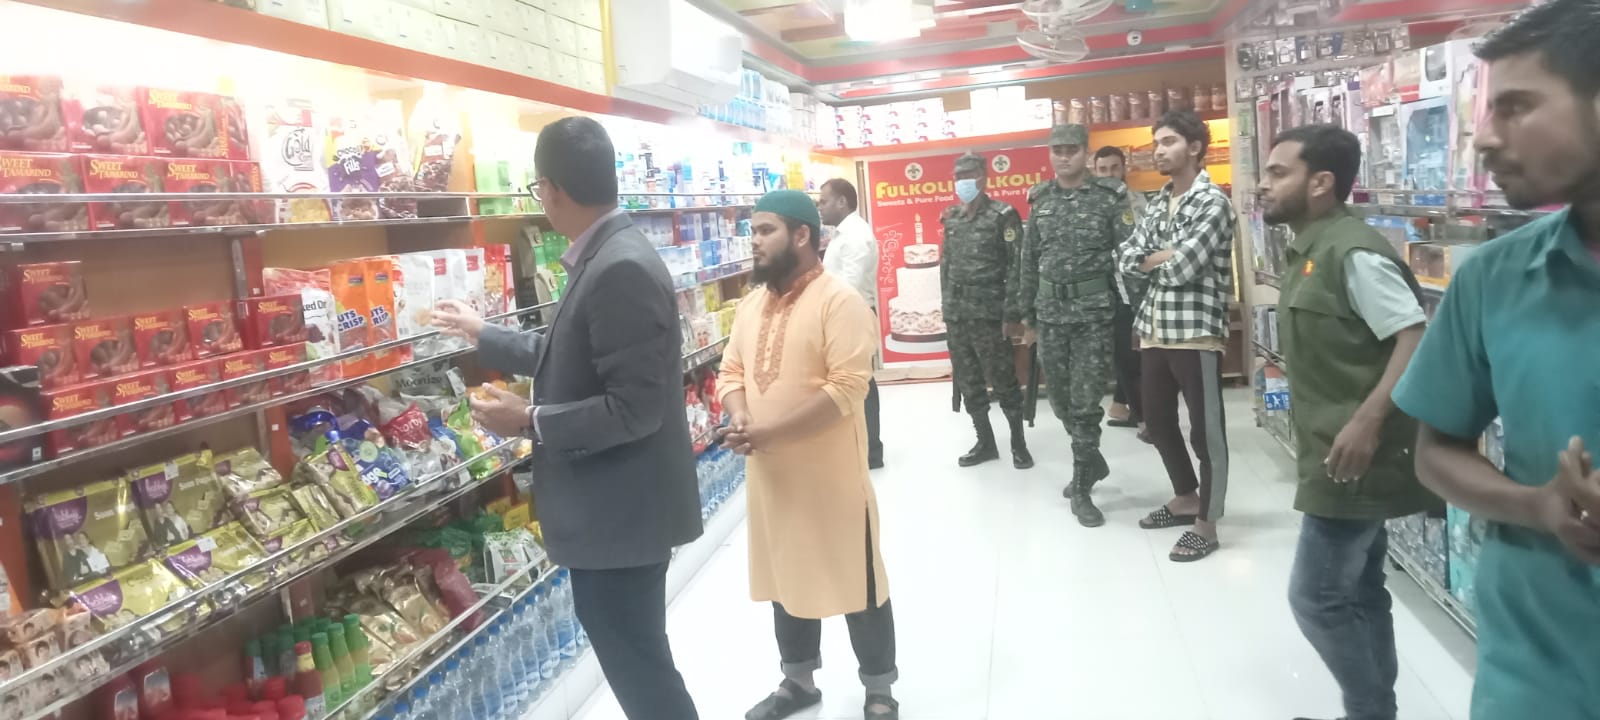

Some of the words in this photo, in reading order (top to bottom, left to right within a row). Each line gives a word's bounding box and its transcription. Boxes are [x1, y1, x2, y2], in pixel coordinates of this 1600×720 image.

[90, 159, 123, 176] SWEET
[986, 172, 1041, 189] LKOLI
[337, 310, 356, 322] UTS
